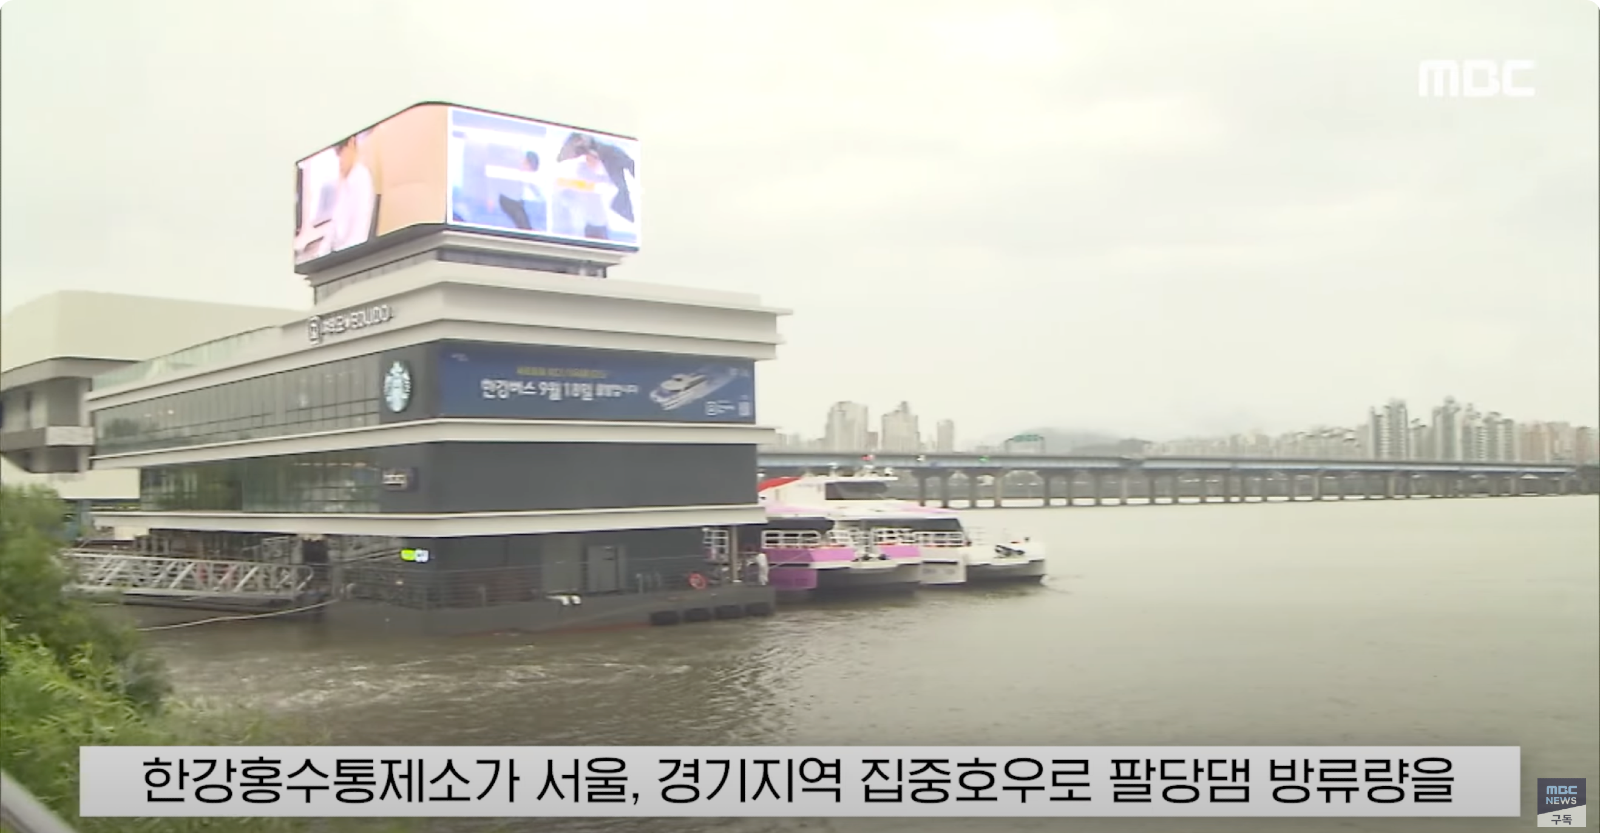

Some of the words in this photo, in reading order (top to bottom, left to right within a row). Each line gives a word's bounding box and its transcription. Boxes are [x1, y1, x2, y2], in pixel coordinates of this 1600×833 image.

[480, 378, 537, 399] 한강버스
[538, 381, 562, 401] 9월
[564, 382, 594, 402] 18일
